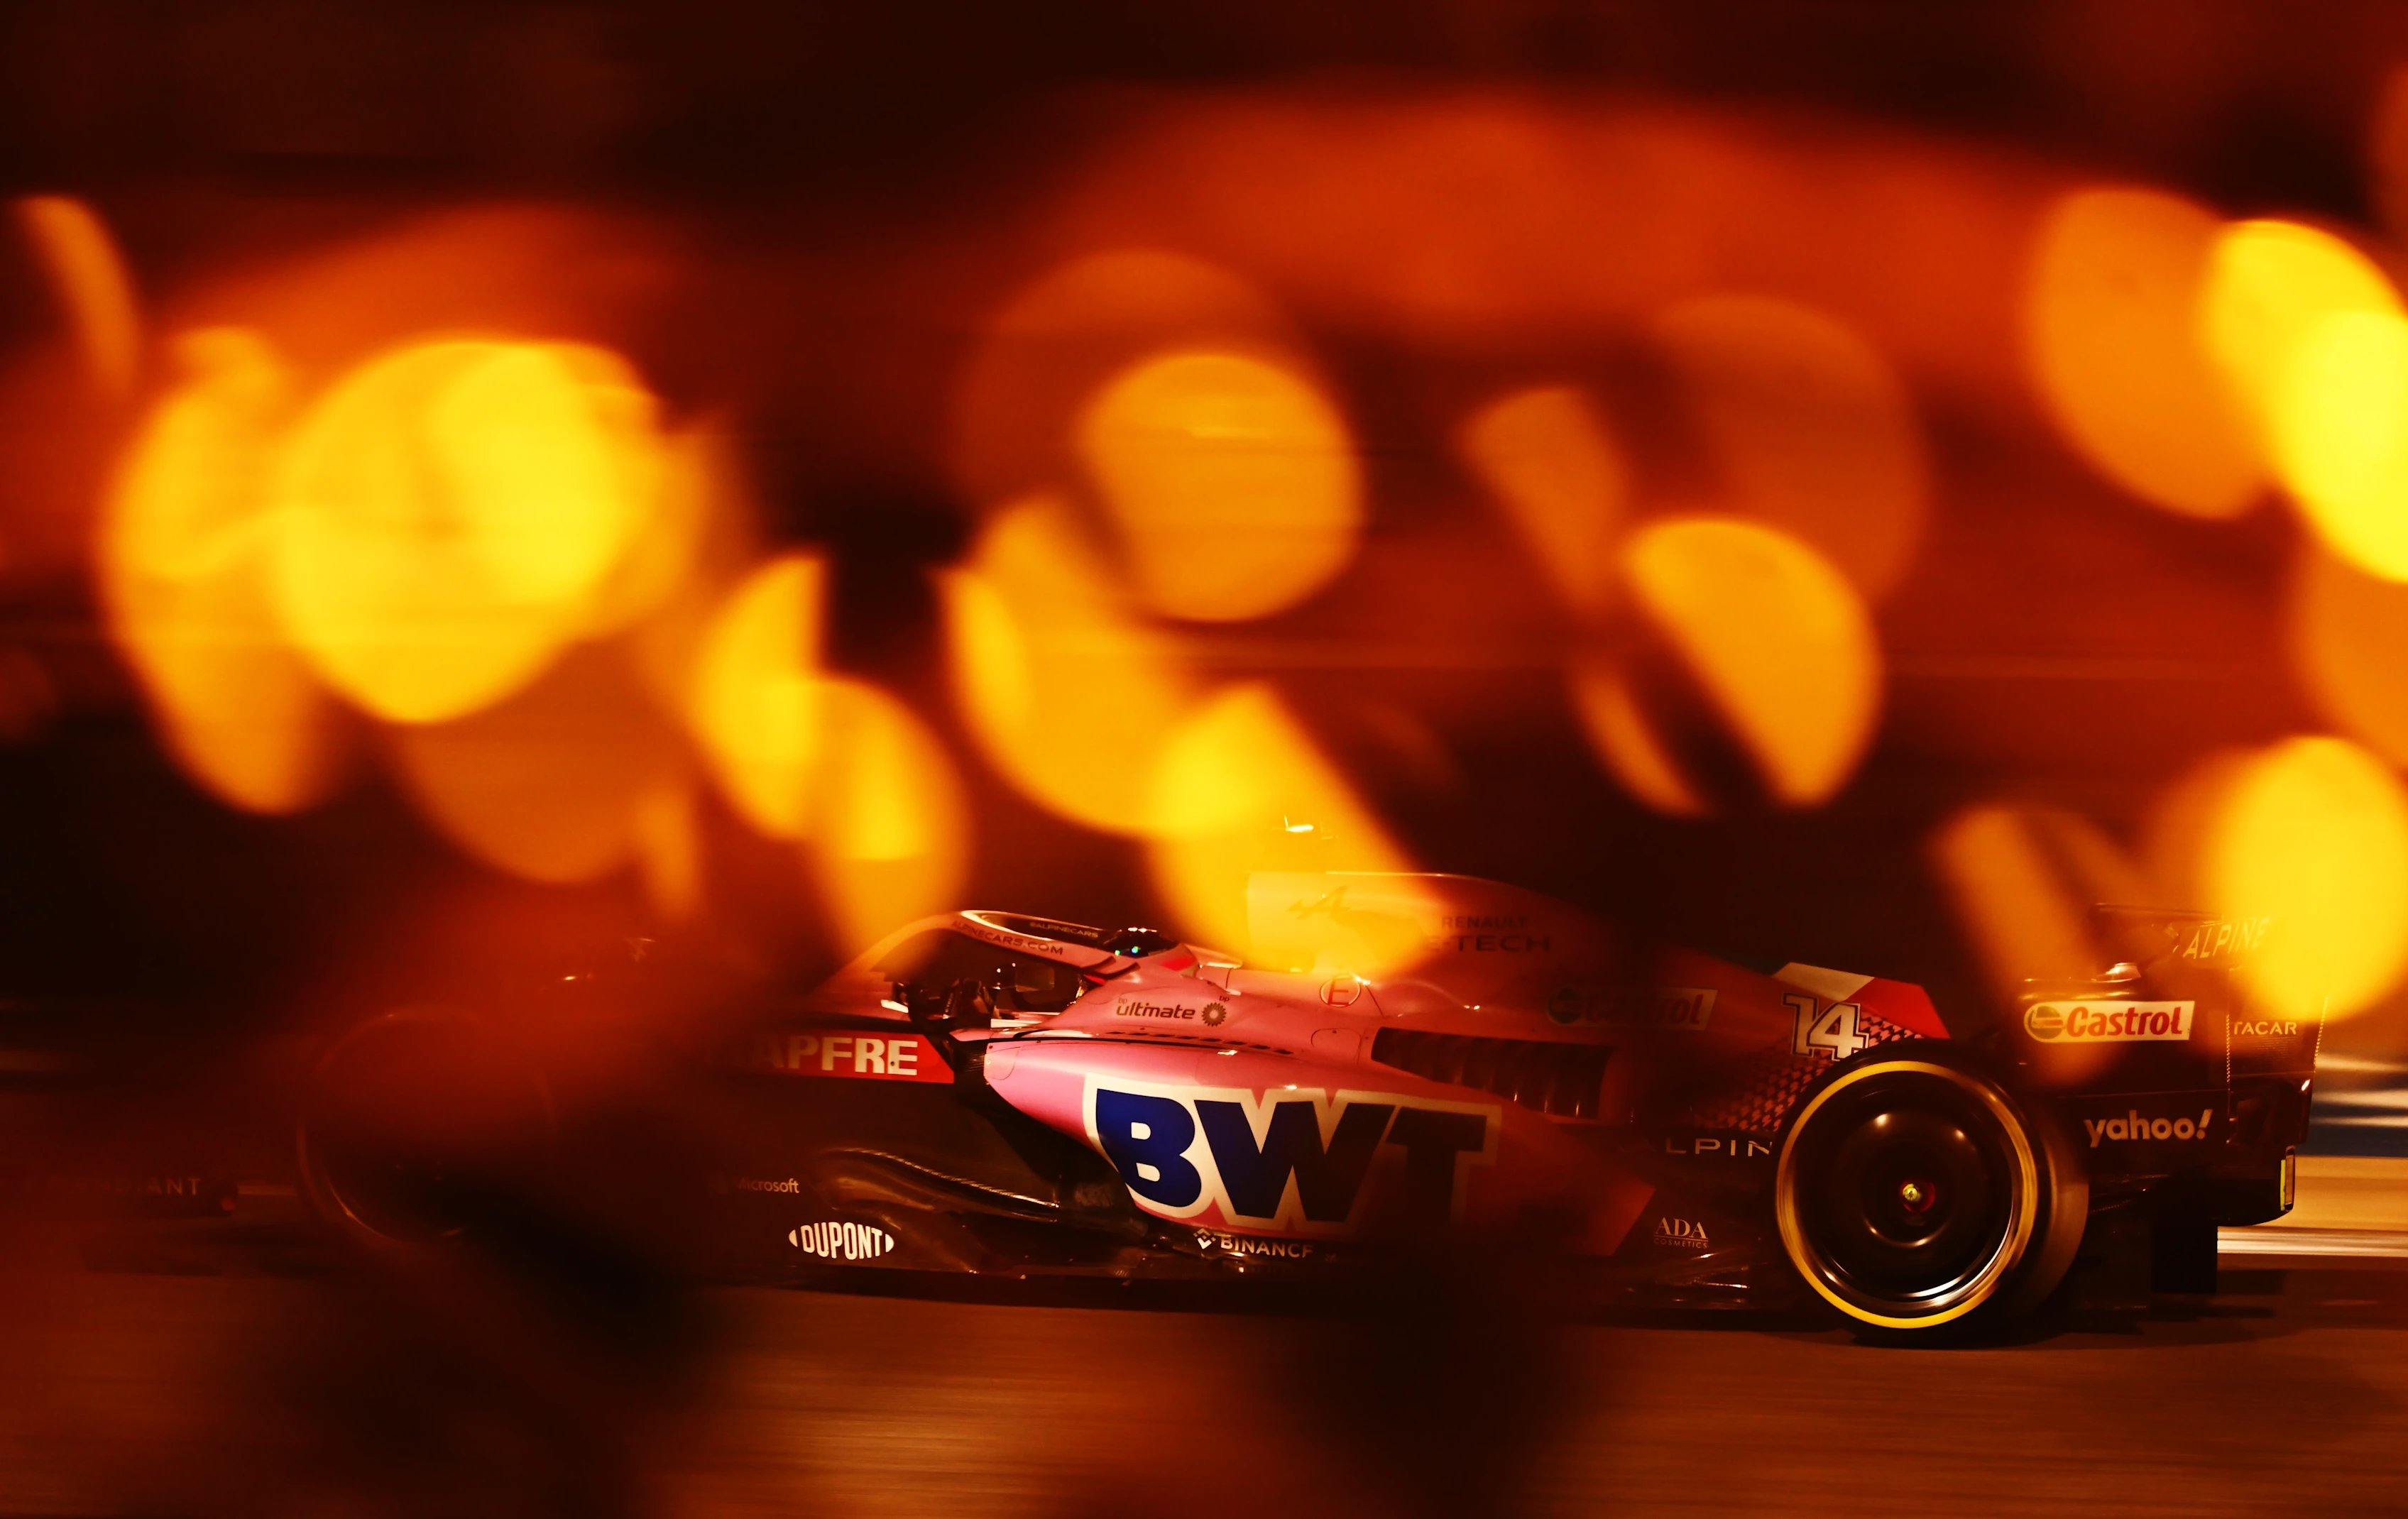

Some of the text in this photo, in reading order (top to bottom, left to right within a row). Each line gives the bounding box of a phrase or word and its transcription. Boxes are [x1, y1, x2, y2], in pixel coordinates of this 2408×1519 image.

[2182, 917, 2270, 959] ALPINE
[1116, 1002, 1195, 1019] ultimate
[1783, 993, 1868, 1061] 14
[2067, 1007, 2182, 1037] Castrol
[756, 1035, 918, 1075] APFRE
[2084, 1109, 2213, 1148] yahoo!
[1095, 1087, 1491, 1229] BWT
[800, 1222, 882, 1260] DUPONT
[1653, 1238, 1708, 1249] COSMETICS
[1655, 1217, 1708, 1239] ADA
